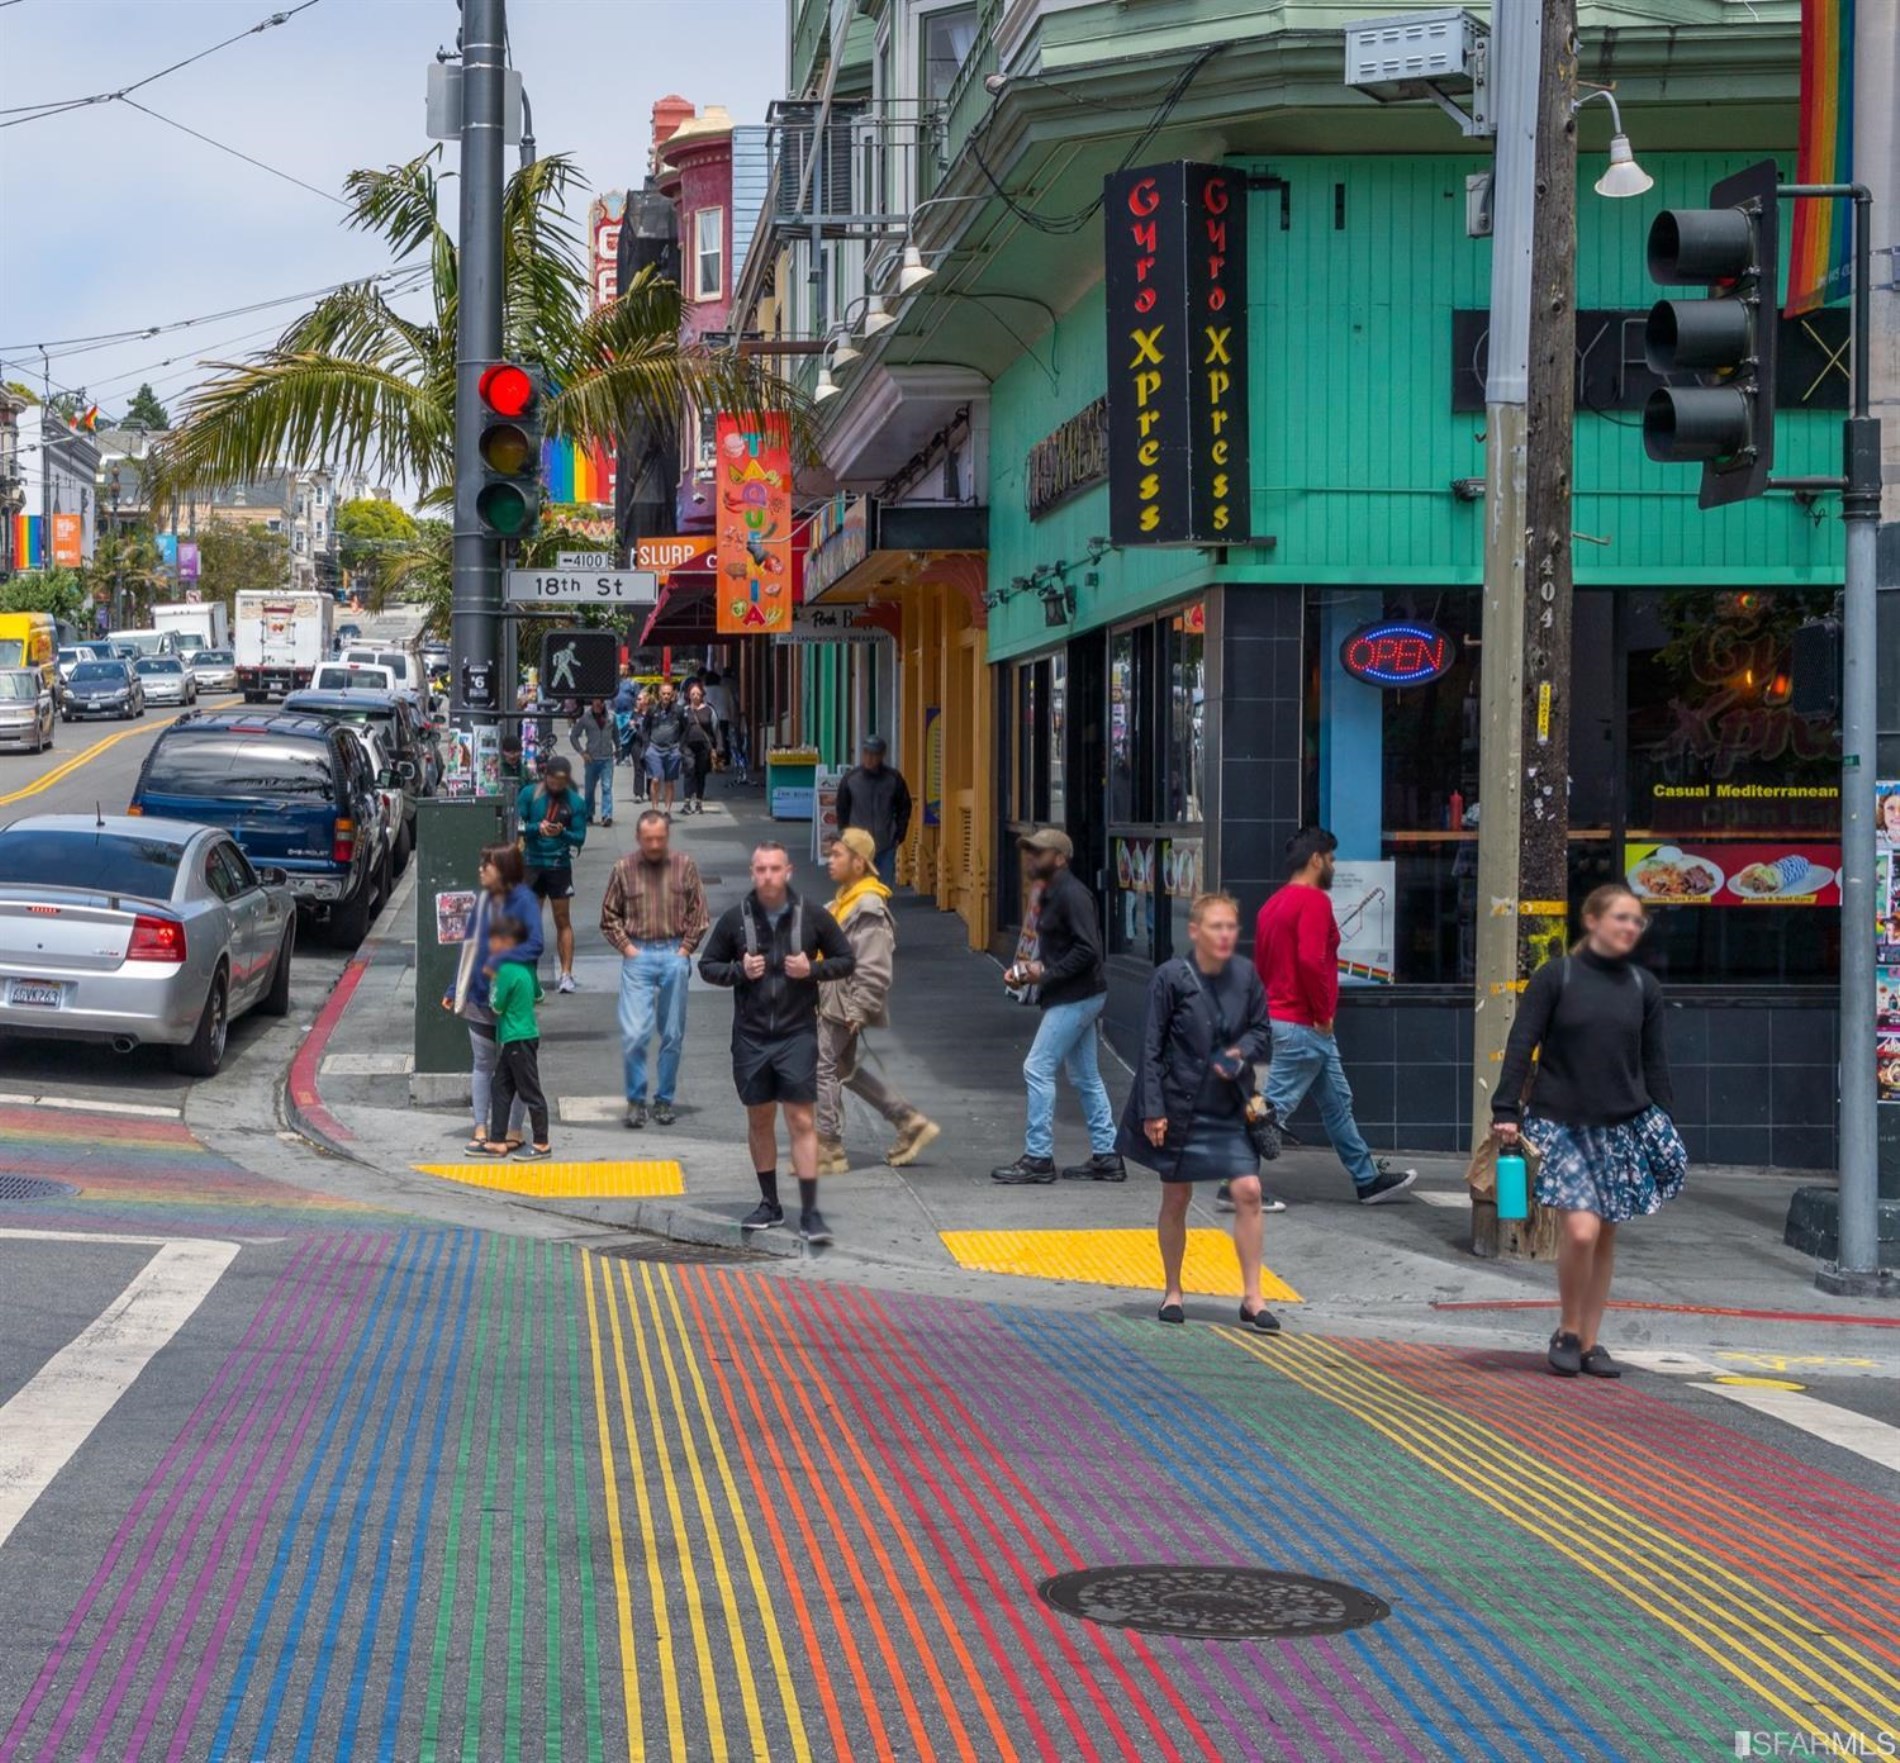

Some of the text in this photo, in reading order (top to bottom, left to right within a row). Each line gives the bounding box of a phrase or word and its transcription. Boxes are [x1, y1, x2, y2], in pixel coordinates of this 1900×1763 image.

[1128, 178, 1166, 532] Gyro Xpress
[1203, 178, 1232, 531] Gyro Xpress
[573, 554, 602, 567] 4100
[639, 544, 695, 566] SLURP
[536, 577, 623, 596] 18th St
[1346, 637, 1444, 672] OPEN
[1653, 784, 1839, 798] Casual Mediterranean
